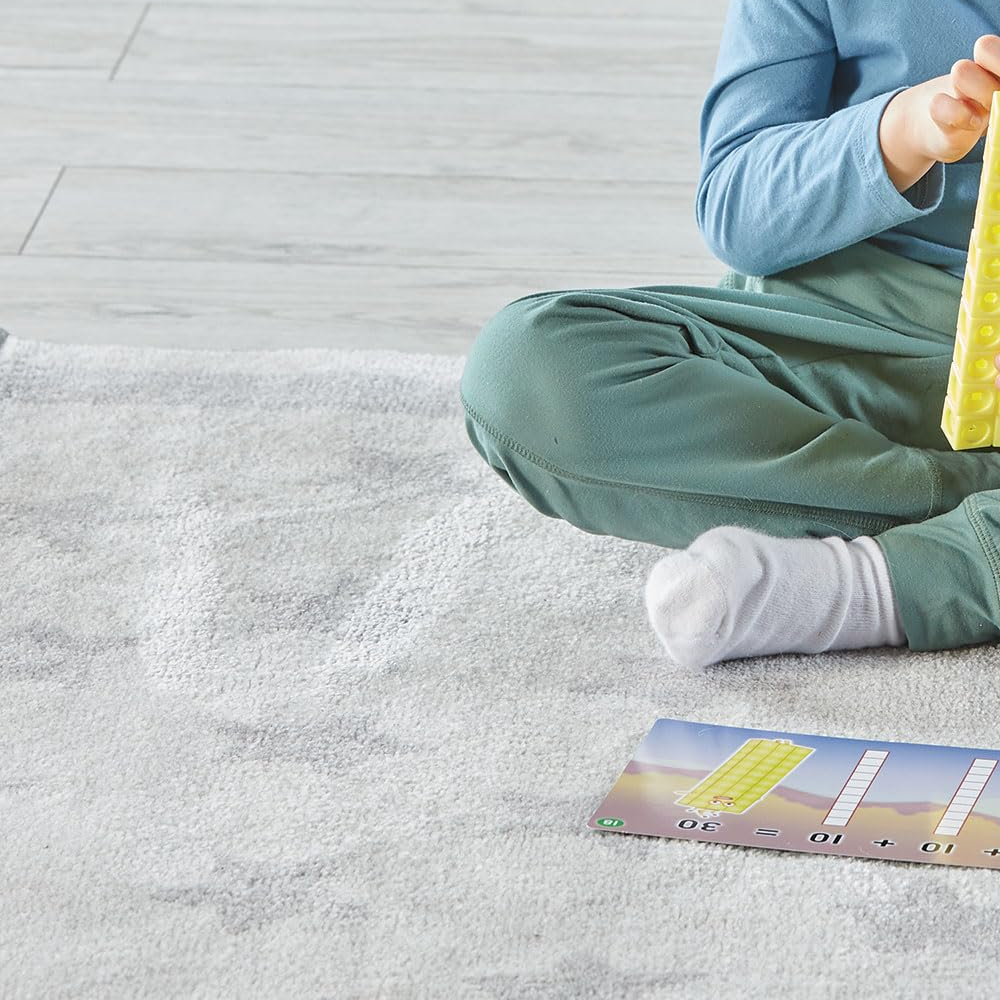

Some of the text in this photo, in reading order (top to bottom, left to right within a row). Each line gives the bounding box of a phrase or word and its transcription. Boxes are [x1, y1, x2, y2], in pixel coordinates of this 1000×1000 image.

[677, 819, 721, 832] 30
[809, 832, 843, 845] 10
[921, 842, 954, 854] 10
